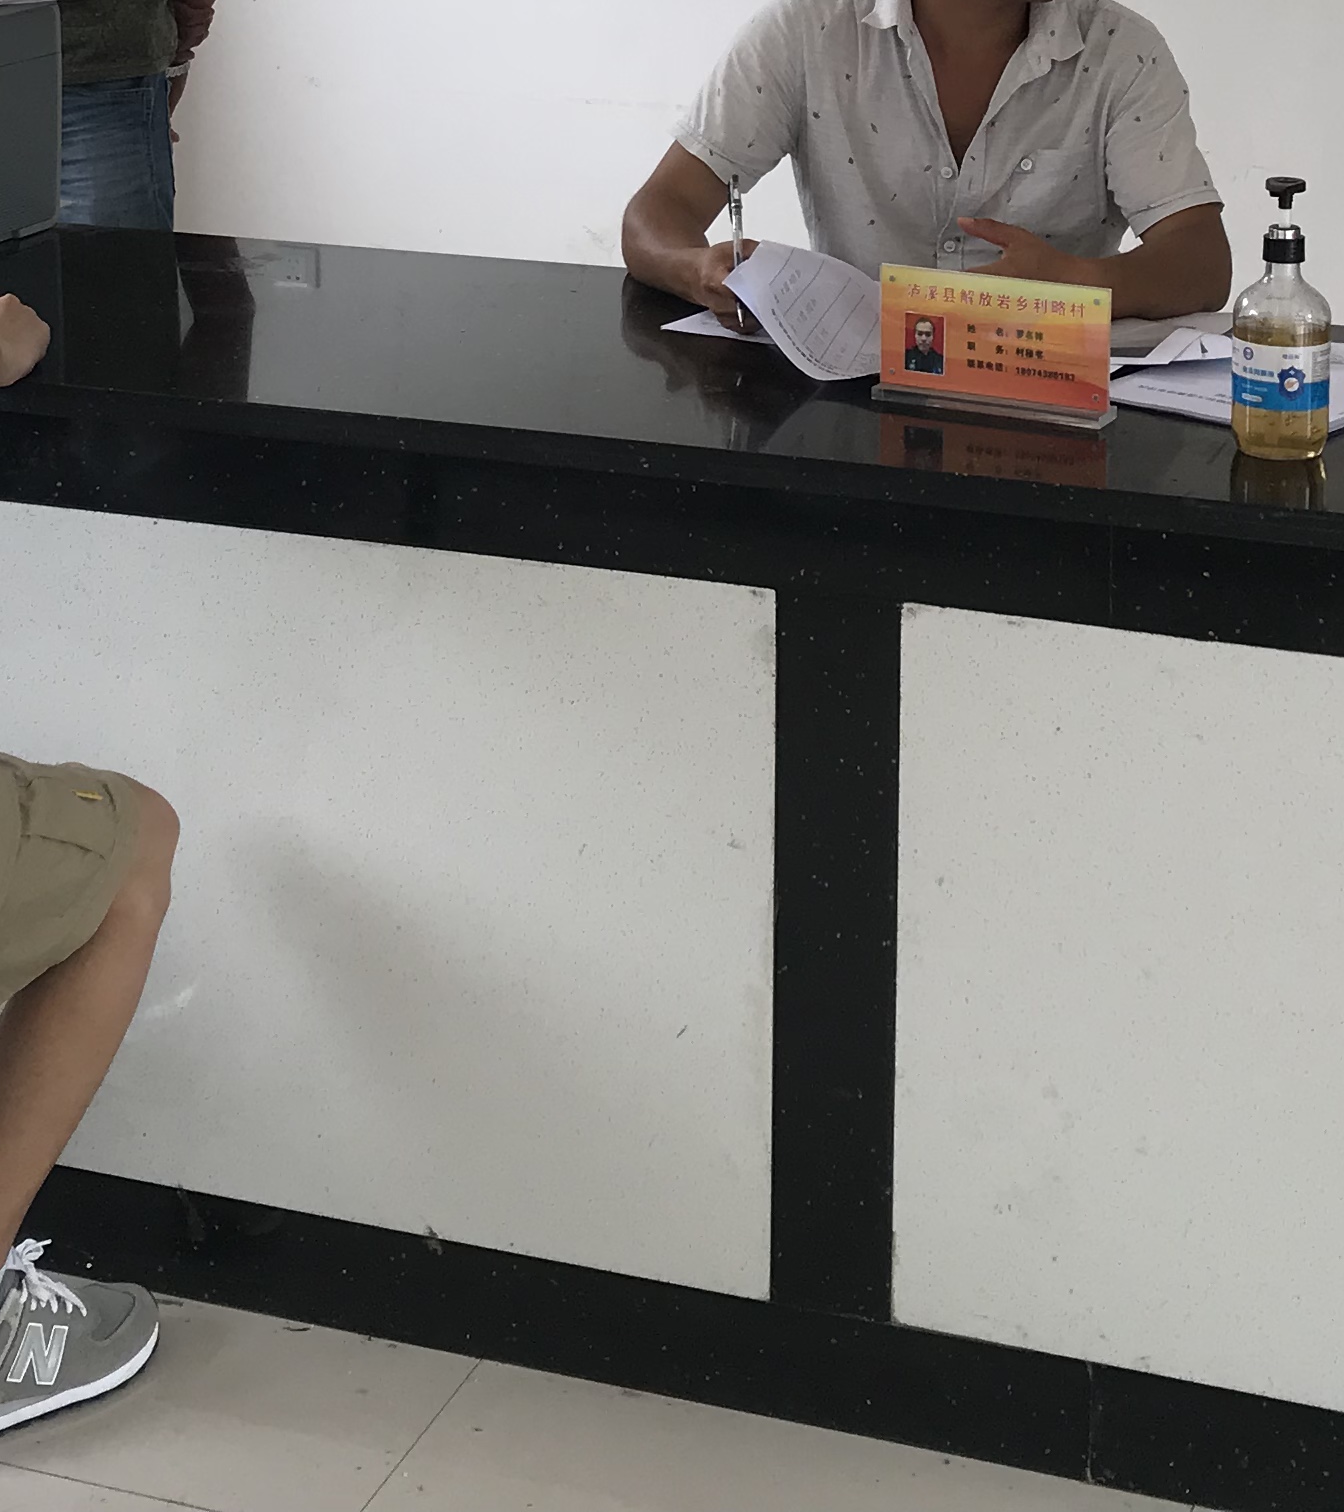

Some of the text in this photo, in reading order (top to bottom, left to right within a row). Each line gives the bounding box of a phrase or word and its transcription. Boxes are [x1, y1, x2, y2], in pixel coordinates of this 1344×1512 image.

[907, 283, 1086, 319] 泸溪县解放岩乡利略村
[6, 1322, 69, 1386] N
